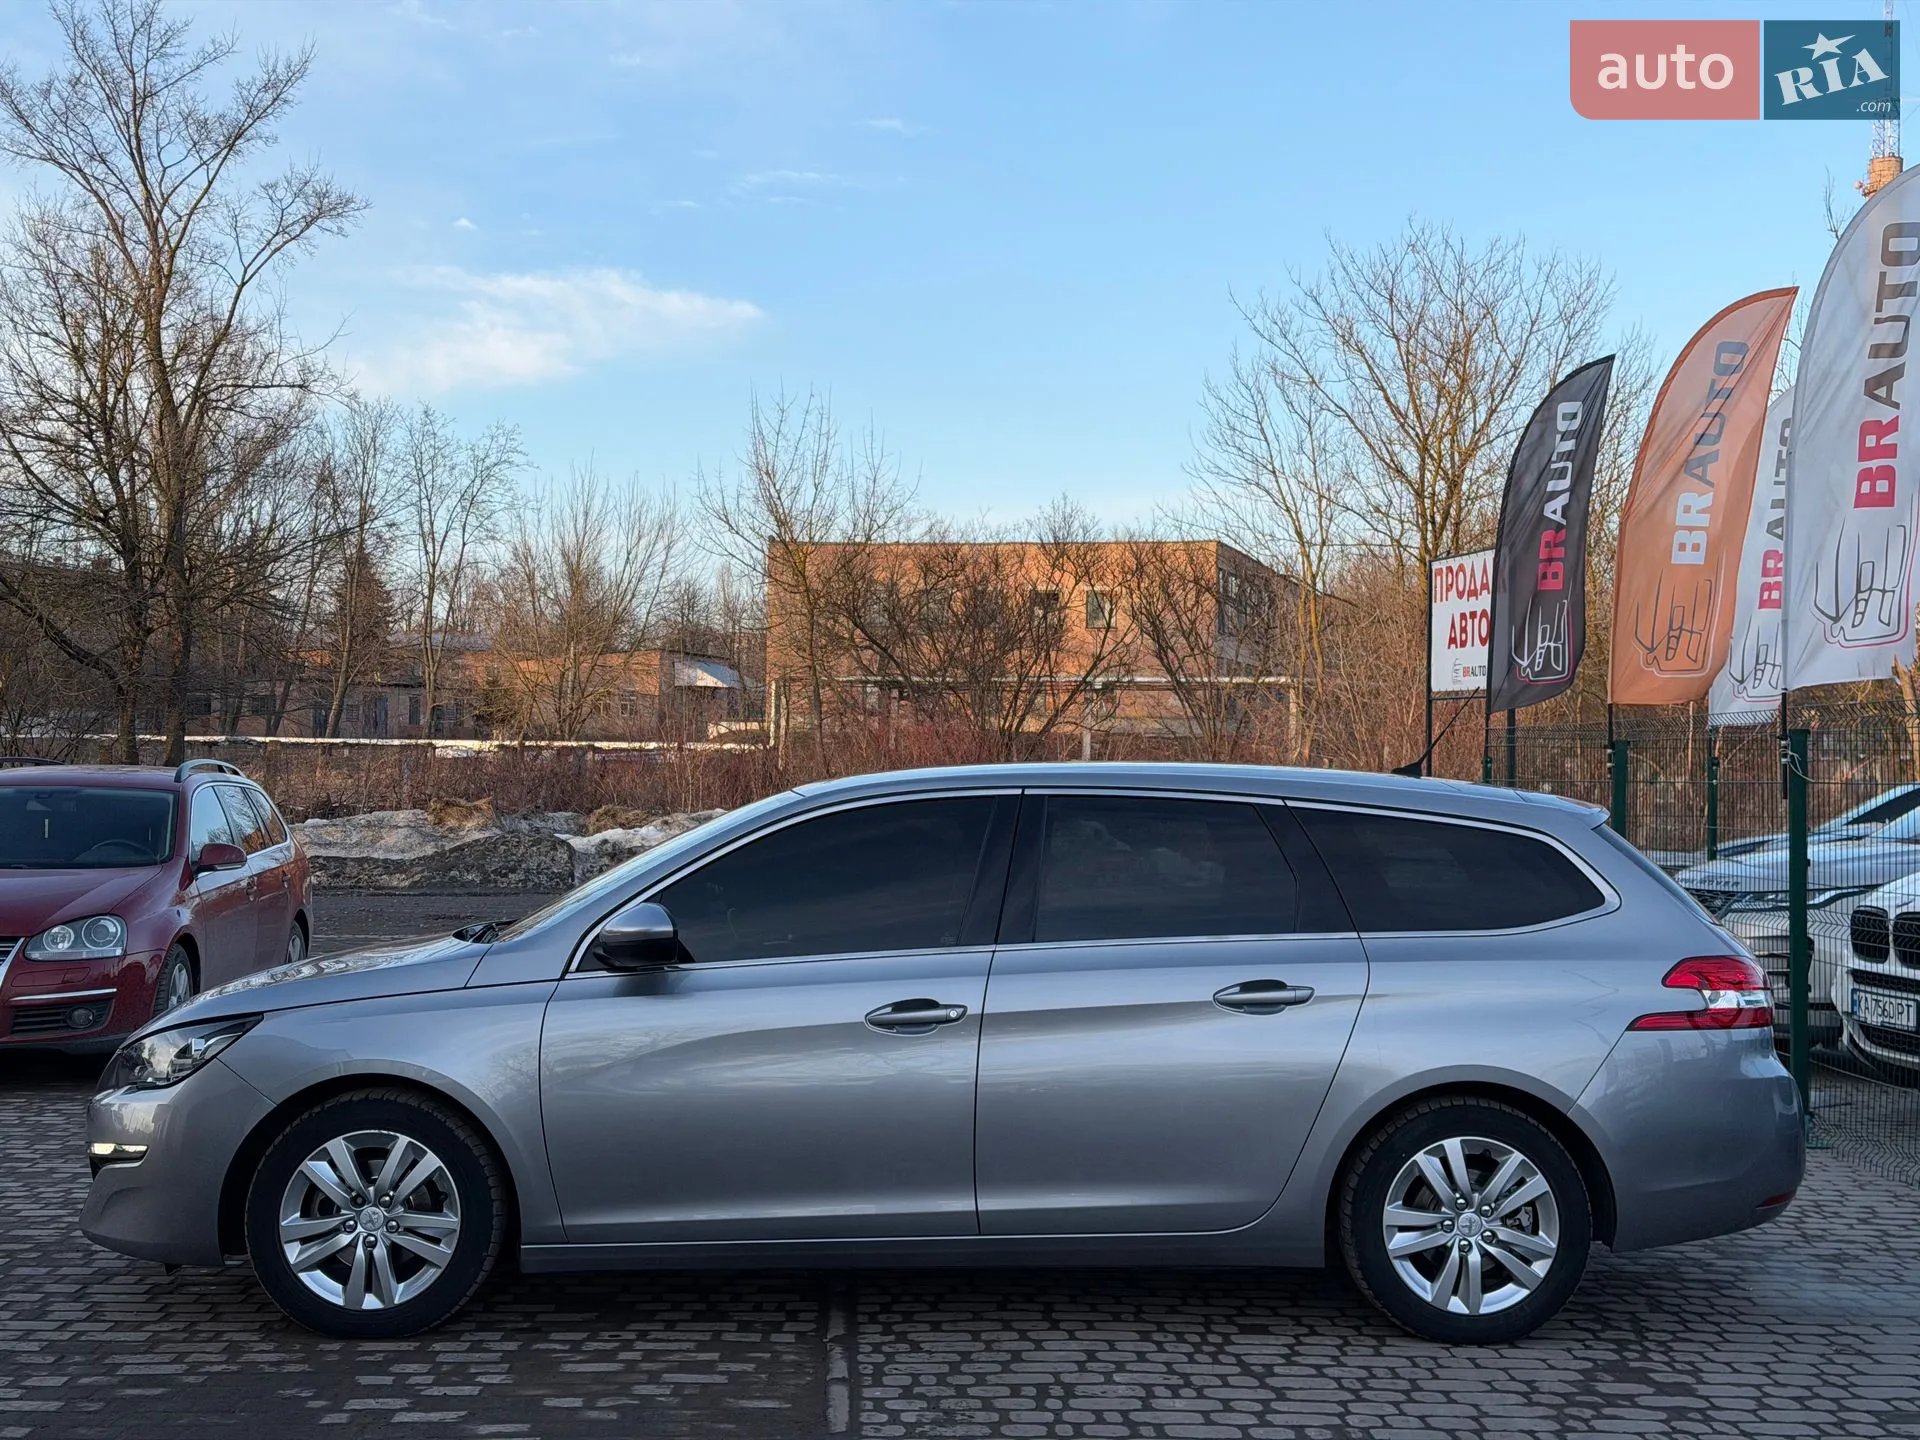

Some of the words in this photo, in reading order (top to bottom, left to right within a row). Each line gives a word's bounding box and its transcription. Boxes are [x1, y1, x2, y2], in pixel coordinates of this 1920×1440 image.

[1671, 340, 1750, 565] BRAUTO
[1852, 221, 1920, 509] BRAUTO
[1433, 558, 1491, 603] ПРОДА
[1537, 401, 1583, 591] BRAUTO
[1447, 608, 1490, 650] АВТО
